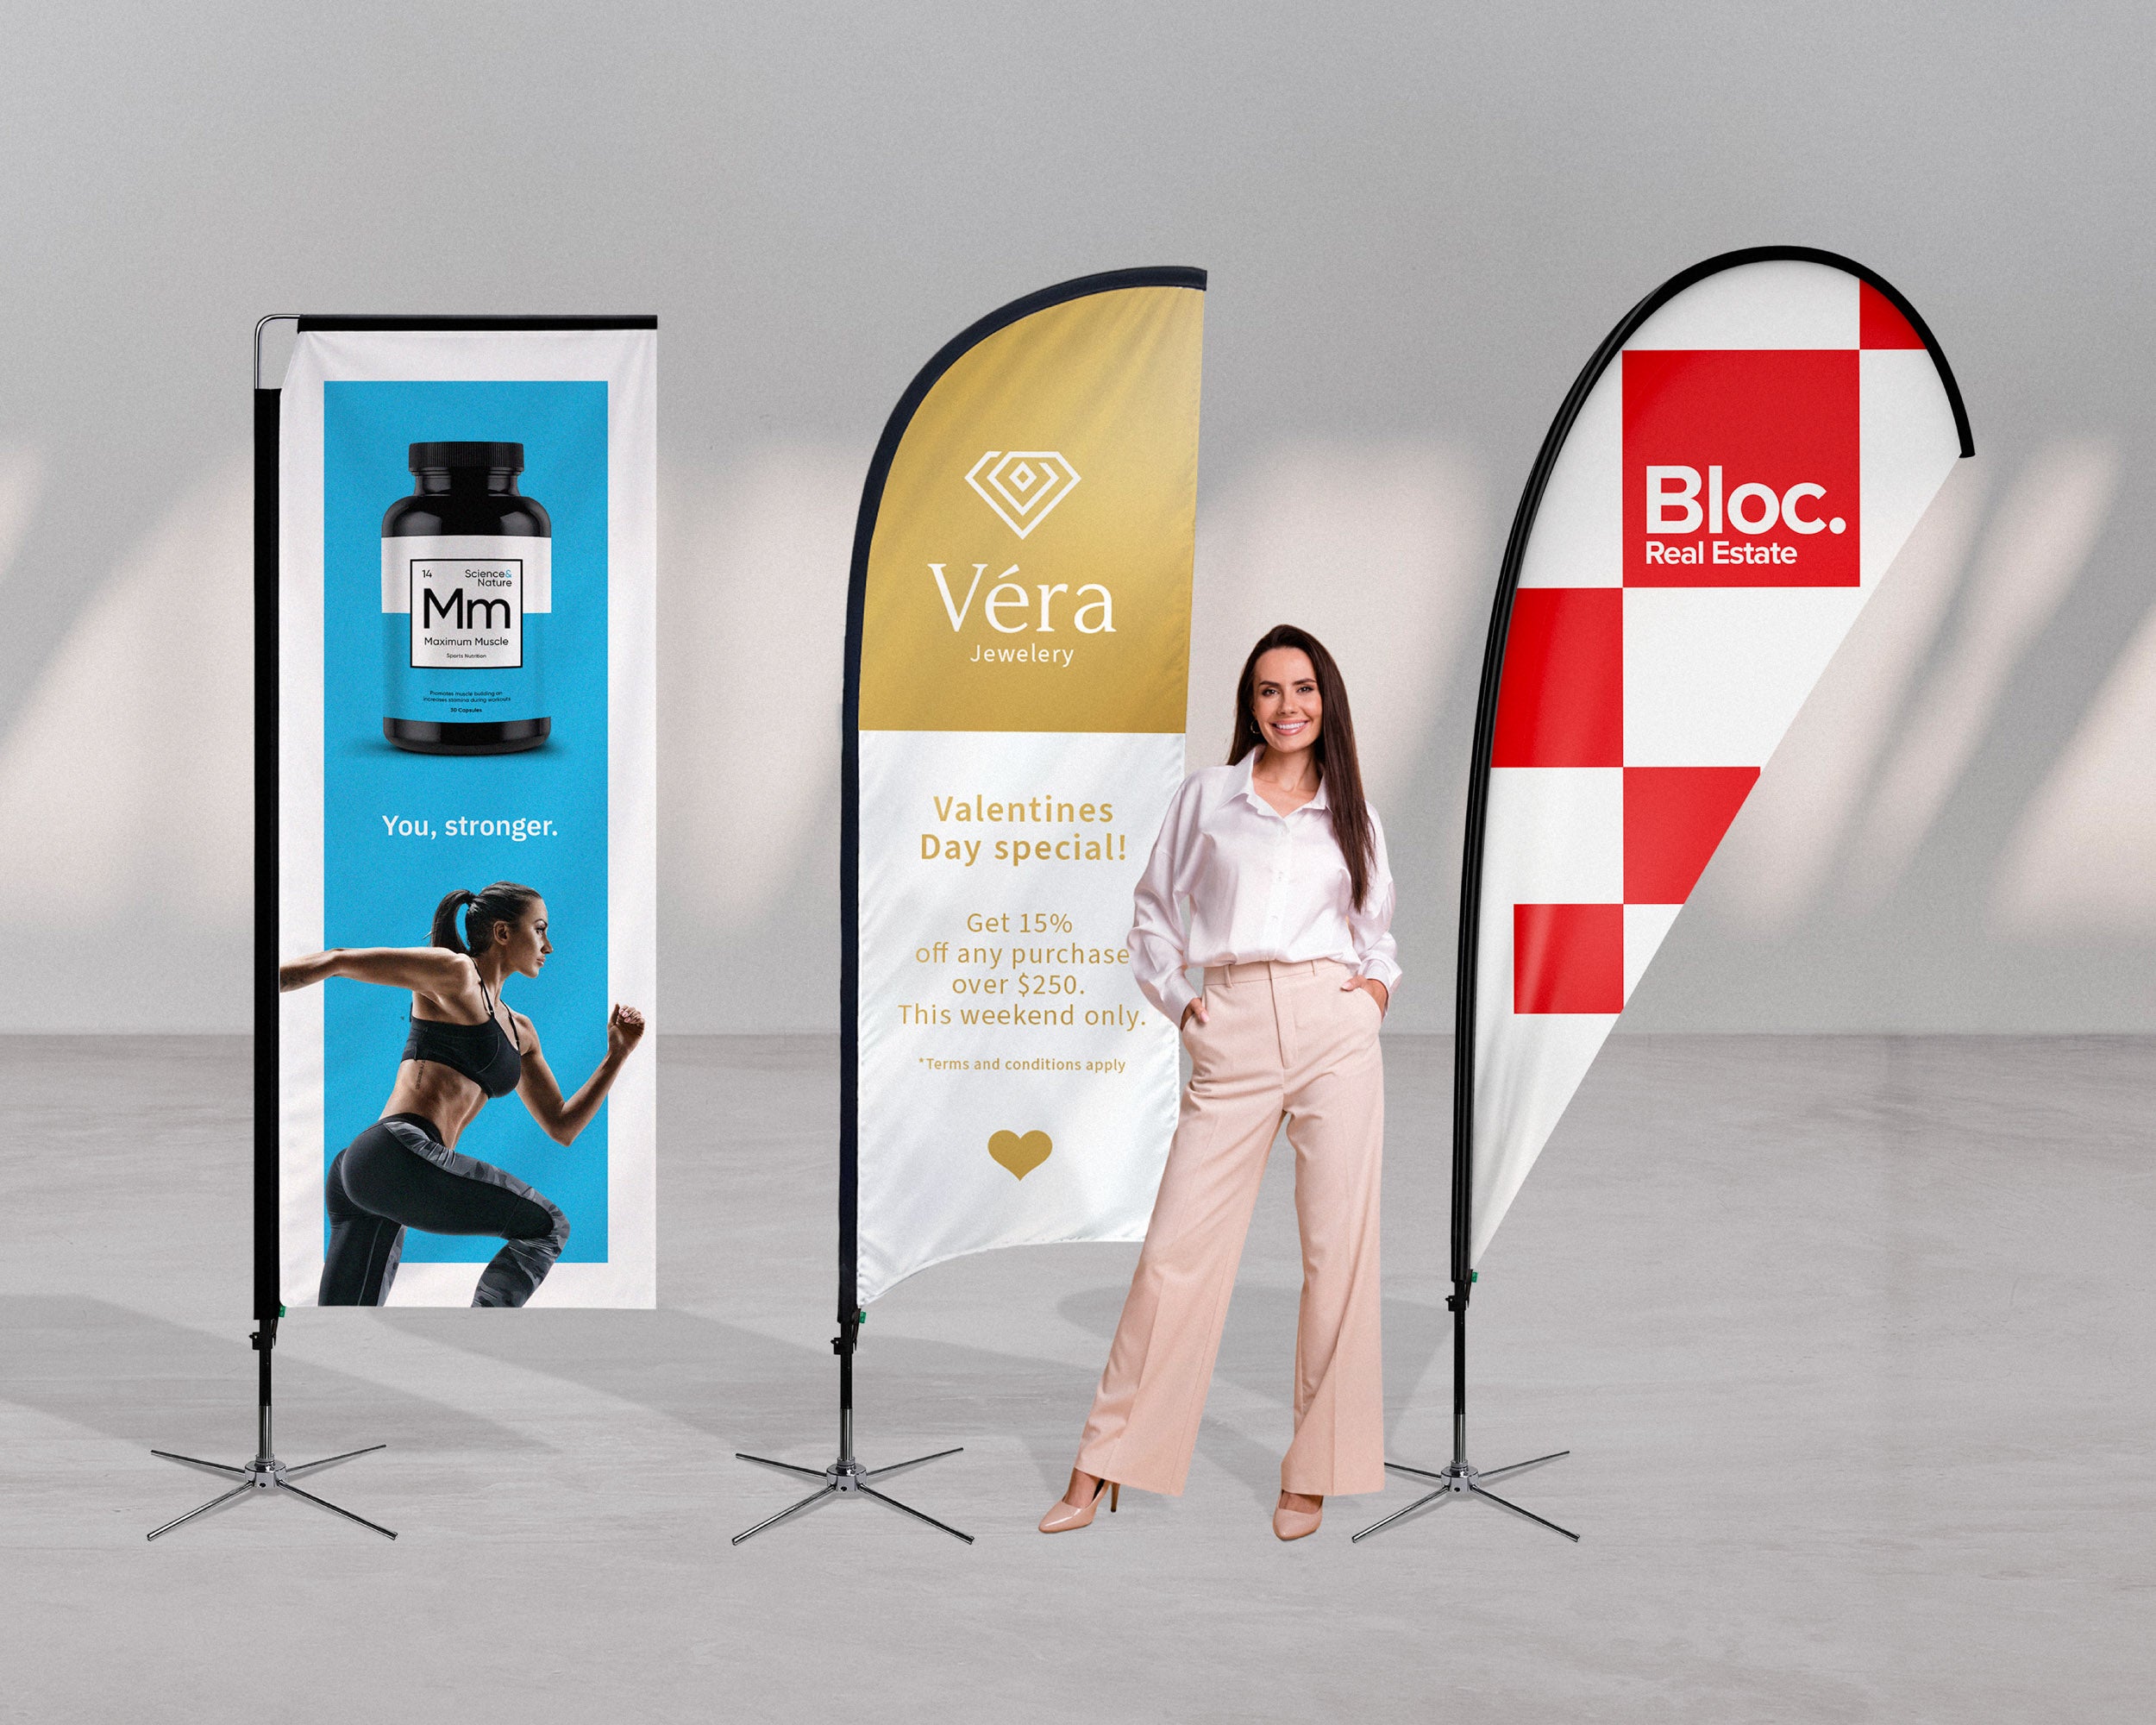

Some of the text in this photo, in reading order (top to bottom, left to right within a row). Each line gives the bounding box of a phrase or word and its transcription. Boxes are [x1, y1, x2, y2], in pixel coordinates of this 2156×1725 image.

[1646, 465, 1846, 535] Bloc.
[1645, 541, 1798, 565] Real Estate
[422, 569, 432, 578] 14
[423, 588, 511, 630] Mm
[927, 562, 1116, 634] Véra
[424, 637, 509, 646] Maximum Muscle
[970, 643, 1074, 668] Jewelery
[933, 794, 1114, 824] Valentines
[382, 815, 558, 842] You, stronger.
[921, 832, 1126, 867] Day special!
[966, 913, 1073, 933] Get 15%
[915, 942, 1130, 969] off any purchase
[952, 972, 1085, 997] over $250.
[898, 1003, 1146, 1032] This weekend only.
[975, 1057, 1000, 1070] and
[1005, 1057, 1082, 1071] conditions
[1086, 1057, 1126, 1074] apply
